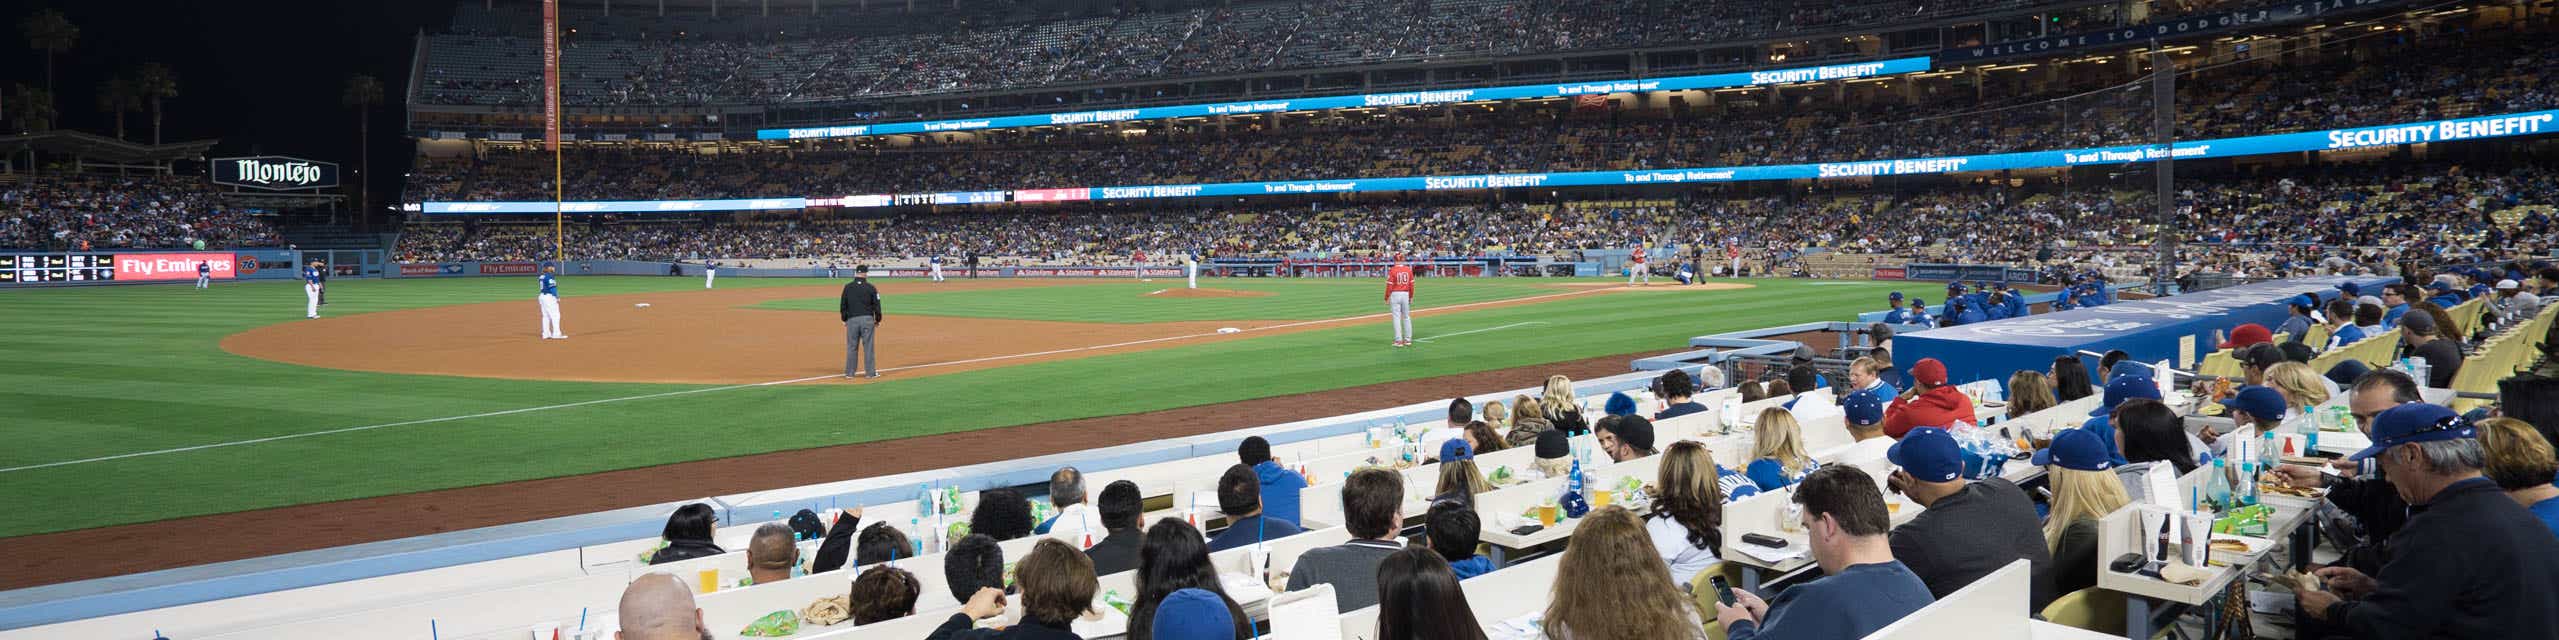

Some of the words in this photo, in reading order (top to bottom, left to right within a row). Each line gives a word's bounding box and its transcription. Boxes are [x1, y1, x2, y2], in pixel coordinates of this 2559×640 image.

[1972, 36, 2086, 57] WELCOME
[2108, 30, 2134, 41] TO
[2158, 10, 2267, 34] DODGER
[1752, 72, 1816, 85] SECURITY
[1820, 63, 1878, 79] BENEFIT
[1364, 94, 1418, 106] SECURITY
[1420, 91, 1469, 103] BENEFIT
[1051, 113, 1095, 124] SECURITY
[1096, 110, 1136, 121] BENEFIT
[788, 128, 829, 139] SECURITY
[830, 126, 864, 137] BENEFIT
[2328, 124, 2436, 148] SECURITY
[2439, 115, 2541, 140] BENEFIT
[2064, 153, 2077, 164] To
[2078, 152, 2098, 163] and
[2100, 150, 2143, 162] Through
[236, 159, 321, 186] Montejo
[1819, 163, 1891, 178] SECURITY
[1894, 159, 1960, 174] BENEFIT
[1425, 177, 1486, 189] SECURITY
[1487, 175, 1541, 187] BENEFIT
[1102, 187, 1152, 199] SECURITY
[1153, 185, 1197, 197] BENEFIT
[122, 259, 153, 275] Fly
[156, 257, 231, 273] Emirtes
[240, 260, 257, 270] 76
[1396, 271, 1409, 285] 10
[2007, 272, 2028, 281] ARCO
